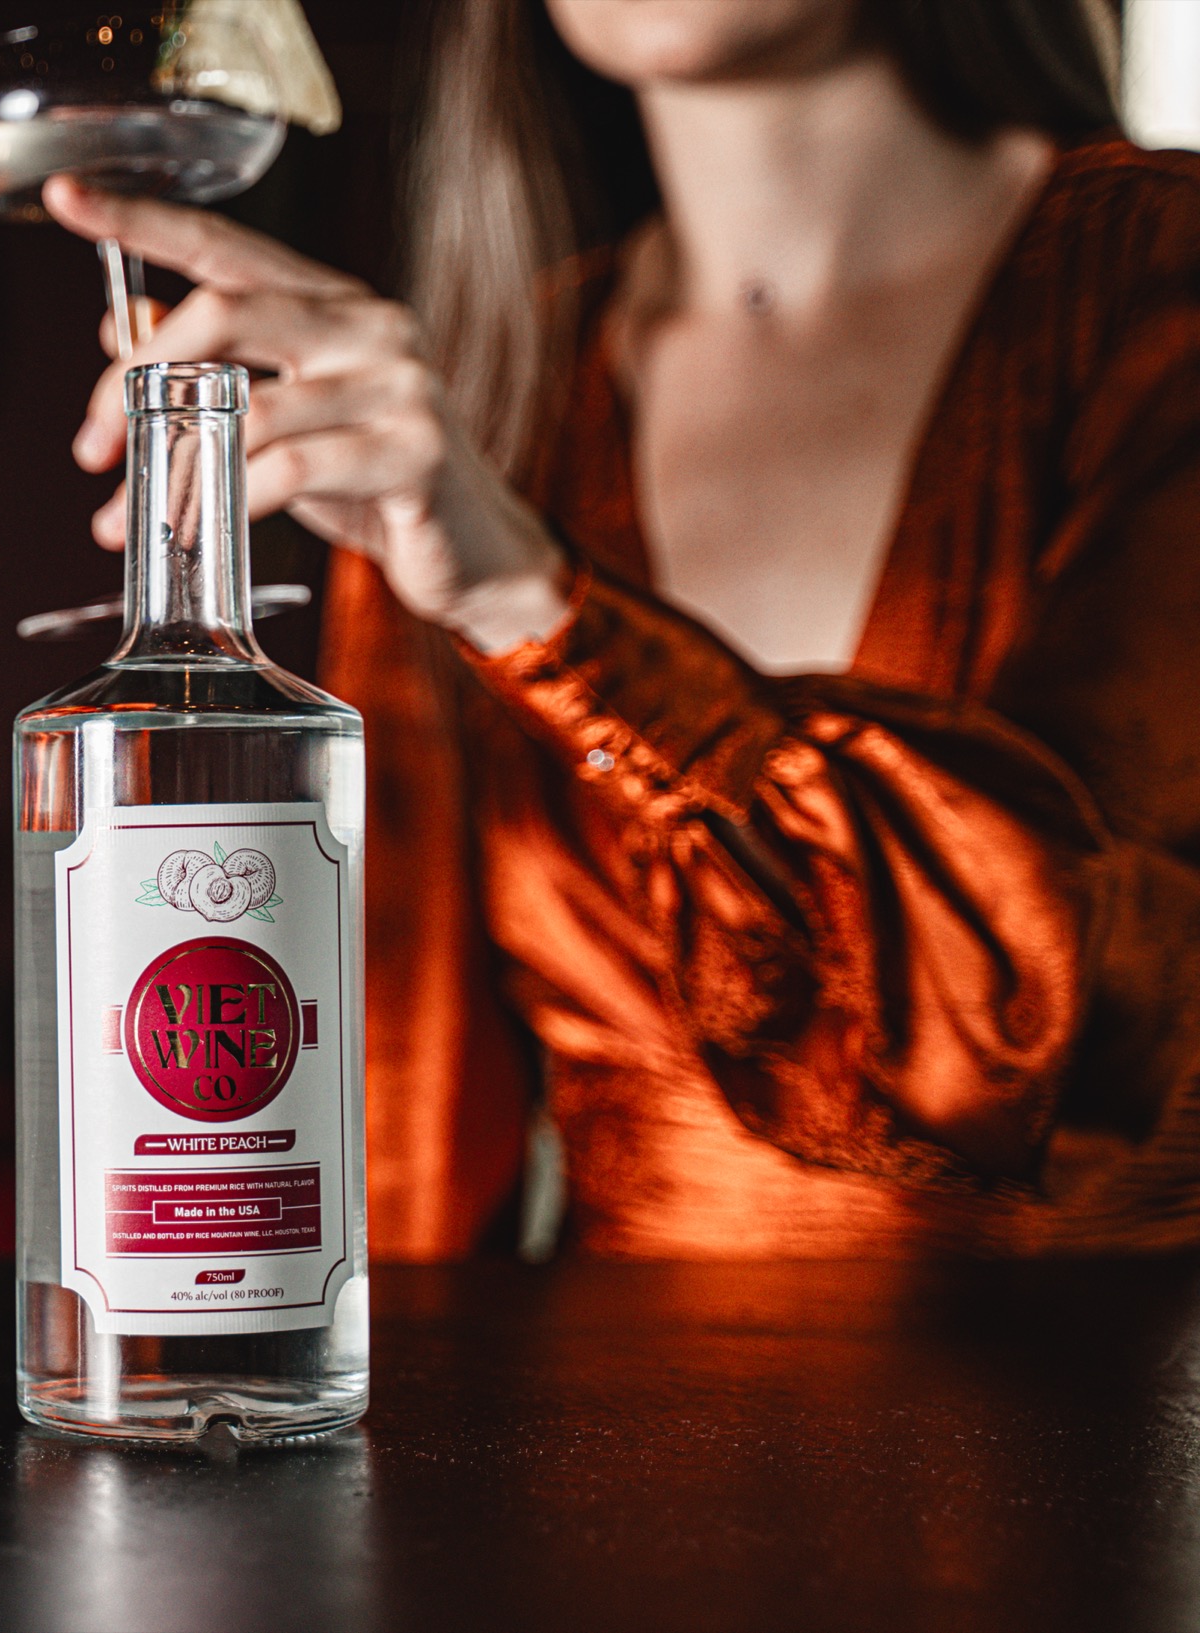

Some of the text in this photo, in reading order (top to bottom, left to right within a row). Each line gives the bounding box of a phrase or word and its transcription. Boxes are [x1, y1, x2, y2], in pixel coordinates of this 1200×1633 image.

[155, 983, 276, 1025] VIET
[151, 1029, 278, 1069] WINE
[193, 1075, 242, 1101] CO.
[167, 1136, 267, 1151] WHITE PEACH
[138, 1184, 173, 1192] DISTILLED
[174, 1184, 194, 1192] FROM
[195, 1183, 228, 1192] PREMIUM
[229, 1182, 245, 1191] RICE
[246, 1182, 263, 1190] WITH
[265, 1180, 292, 1189] NATURAL
[294, 1178, 315, 1187] FLAVOR
[174, 1205, 261, 1217] Made in the USA
[112, 1232, 142, 1240] DISTILLED
[143, 1232, 156, 1240] AND
[157, 1232, 185, 1240] BOTTLED
[211, 1231, 243, 1239] MOUNTAIN
[206, 1272, 235, 1282] 750ml
[171, 1288, 284, 1302] 40% alc/vol (80 PROOF)
